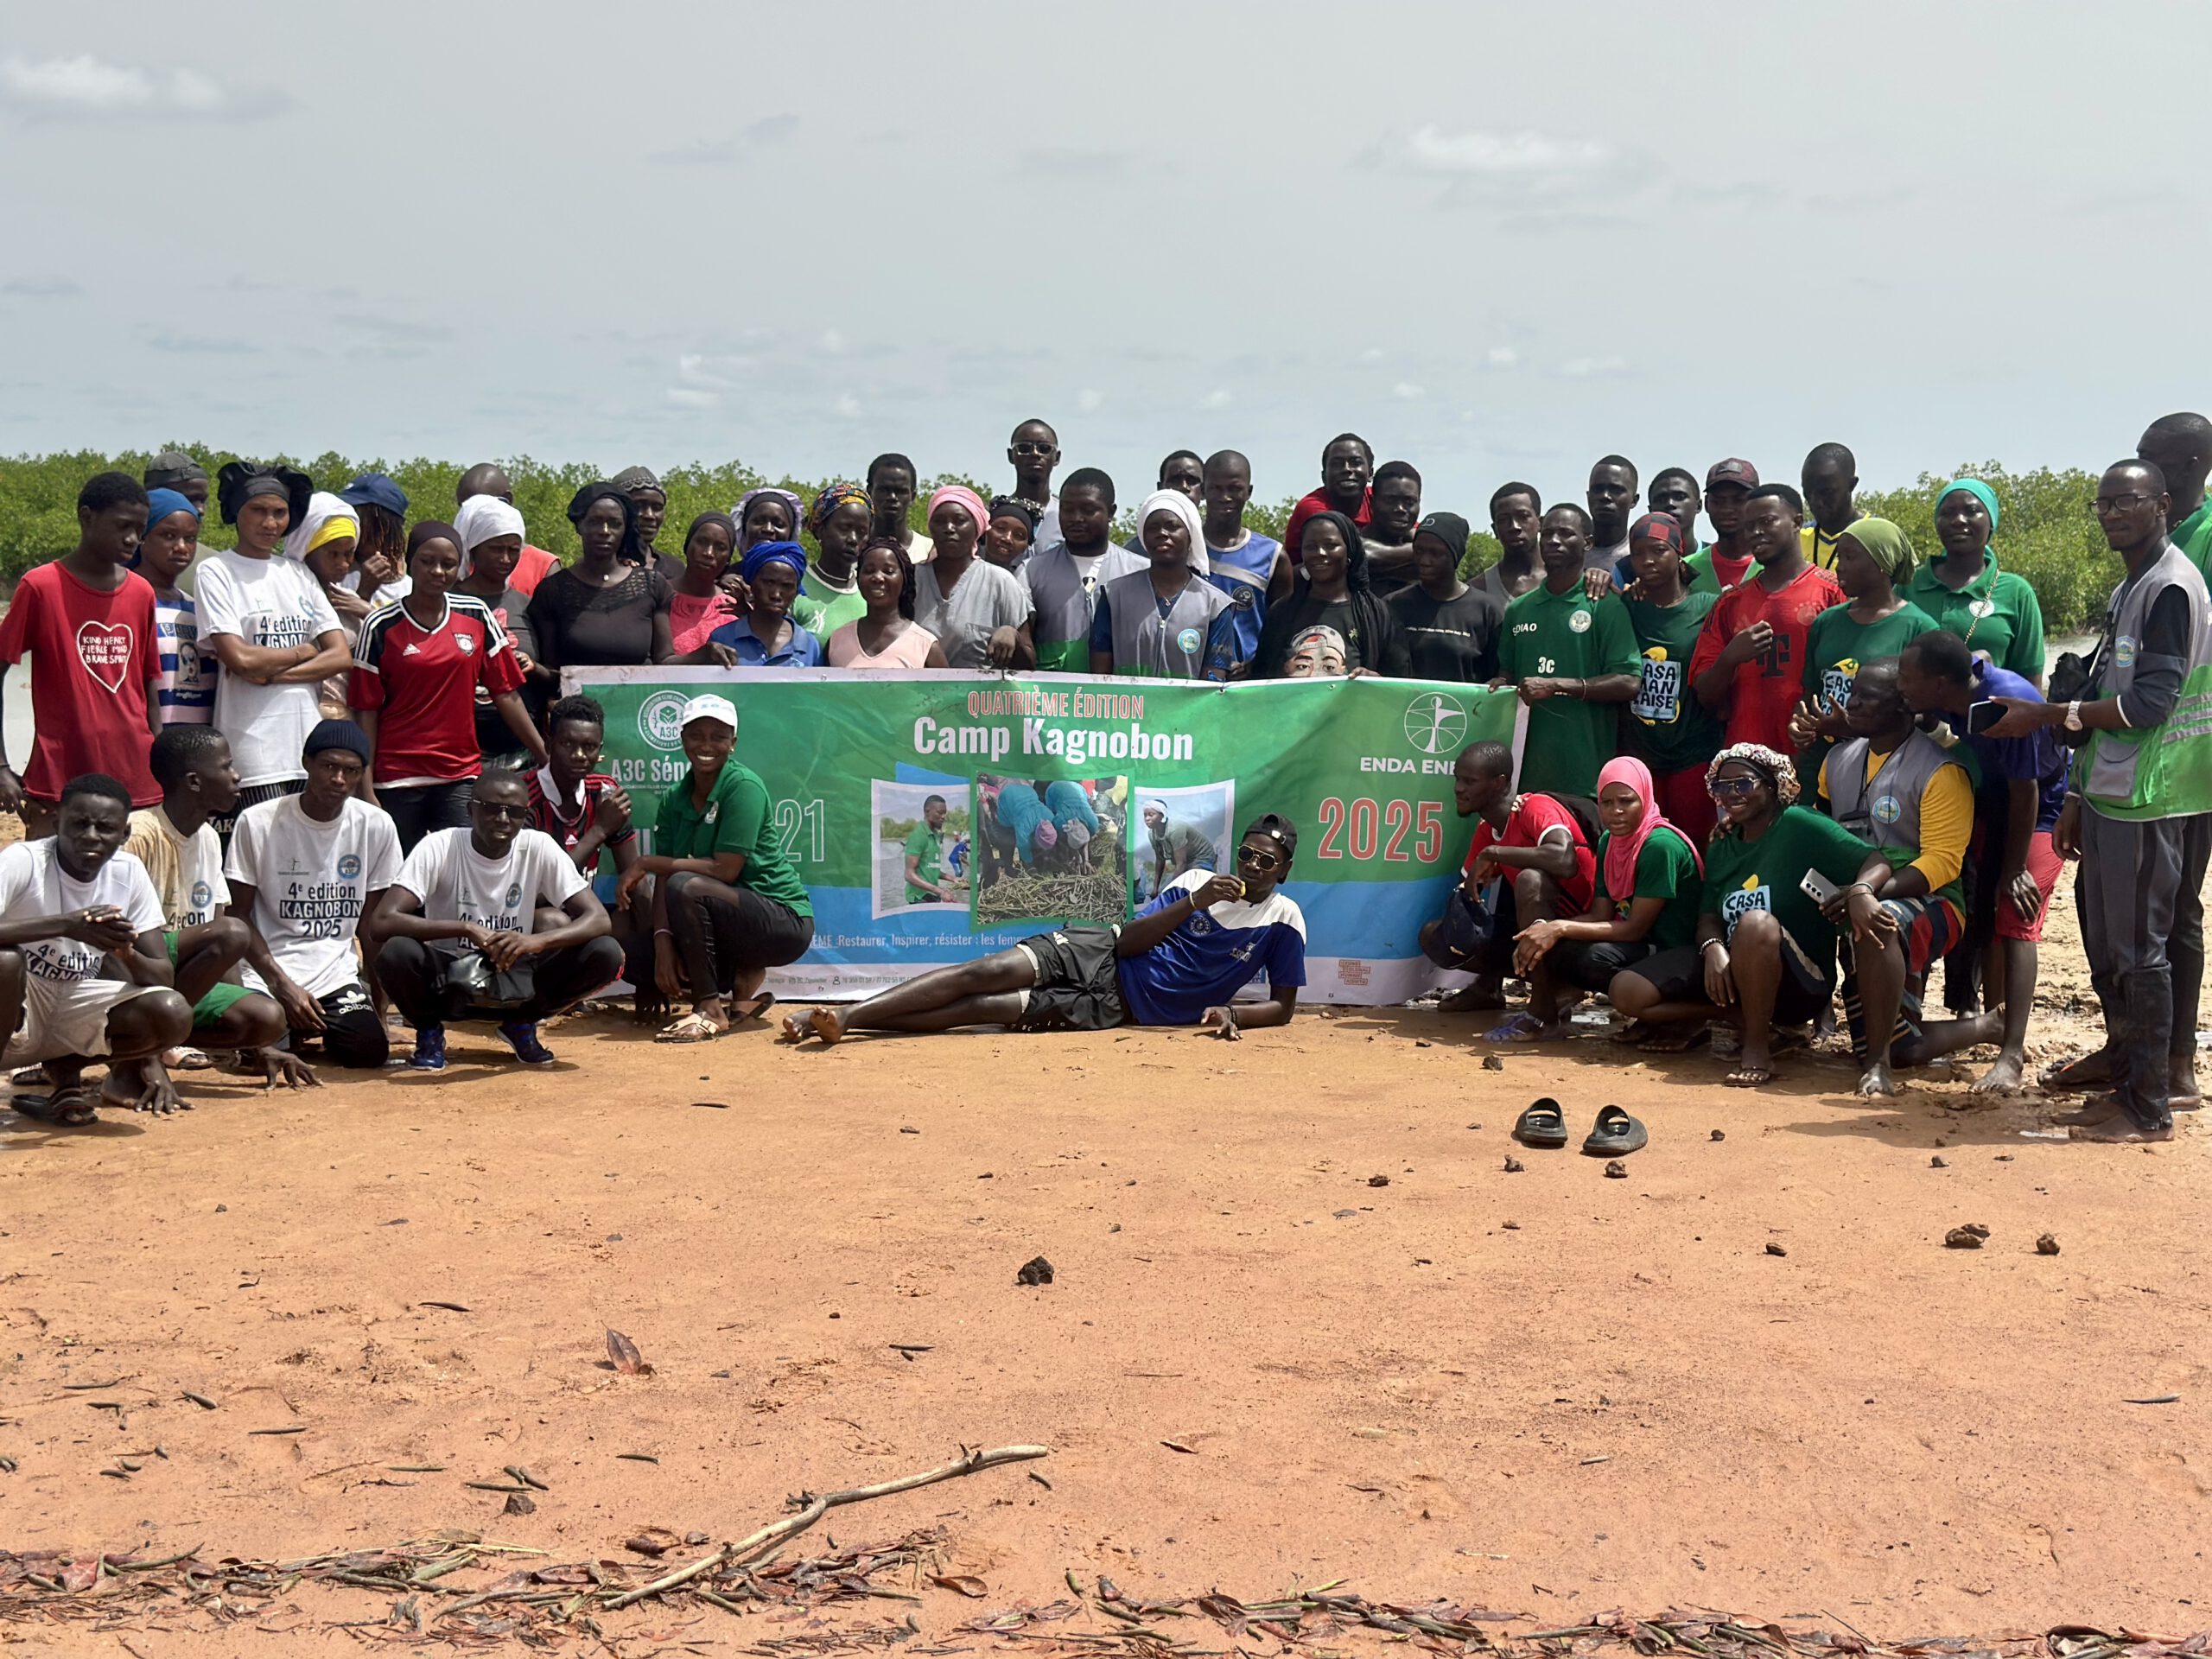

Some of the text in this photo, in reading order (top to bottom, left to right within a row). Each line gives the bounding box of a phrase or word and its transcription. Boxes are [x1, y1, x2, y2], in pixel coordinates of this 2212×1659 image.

[1643, 663, 1675, 680] ASA
[1825, 676, 1853, 693] CAS
[968, 684, 1144, 720] QUATRIÈME ÉDITION
[1634, 692, 1674, 709] AISE
[659, 727, 678, 738] A3C
[913, 716, 1193, 765] Camp Kagnobon
[611, 759, 645, 782] A3C
[1360, 757, 1456, 775] ENDA ENE
[1318, 797, 1443, 863] 2025
[308, 882, 356, 899] edition
[282, 901, 363, 918] KAGNOBON
[1726, 891, 1765, 911] CASA
[301, 918, 342, 939] 2025
[935, 932, 972, 946] résister
[981, 932, 995, 946] les
